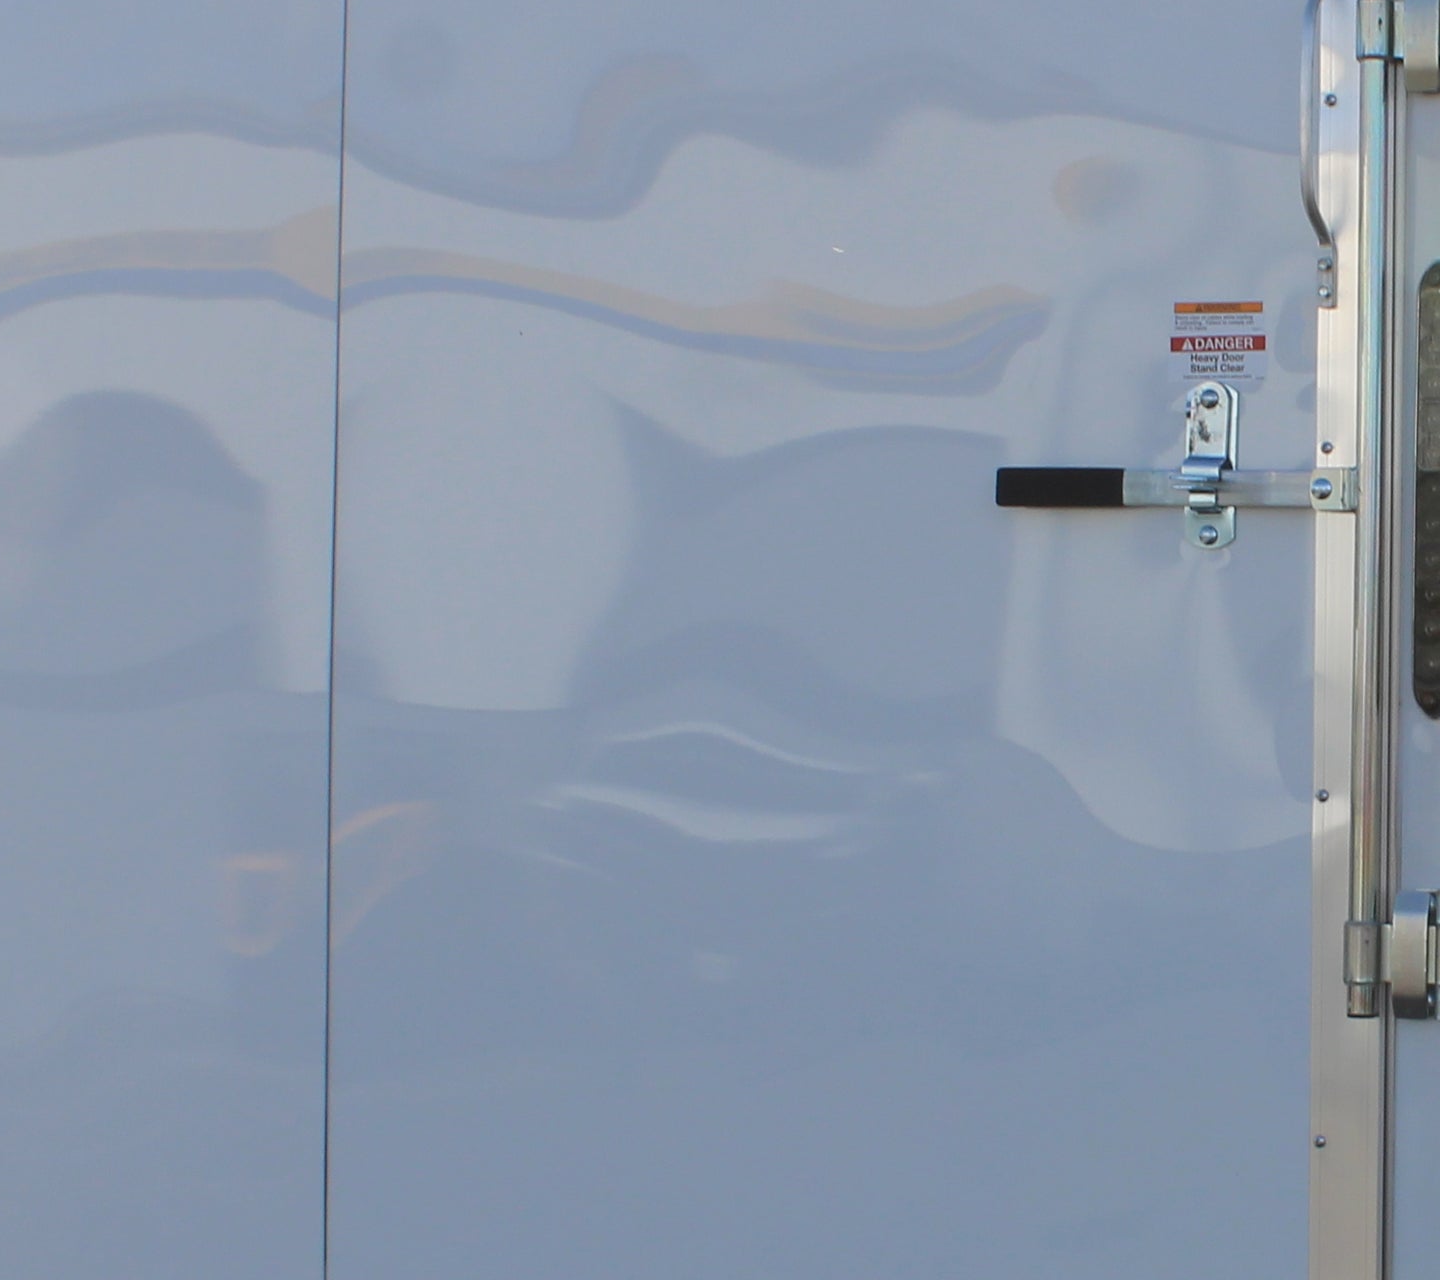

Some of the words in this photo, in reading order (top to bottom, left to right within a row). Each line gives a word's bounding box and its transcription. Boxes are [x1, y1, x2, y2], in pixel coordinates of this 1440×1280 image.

[1195, 336, 1254, 350] DANGER
[1190, 353, 1219, 364] Heavy
[1222, 353, 1245, 362] Door
[1190, 363, 1218, 373] Stand
[1221, 363, 1245, 372] Clear
